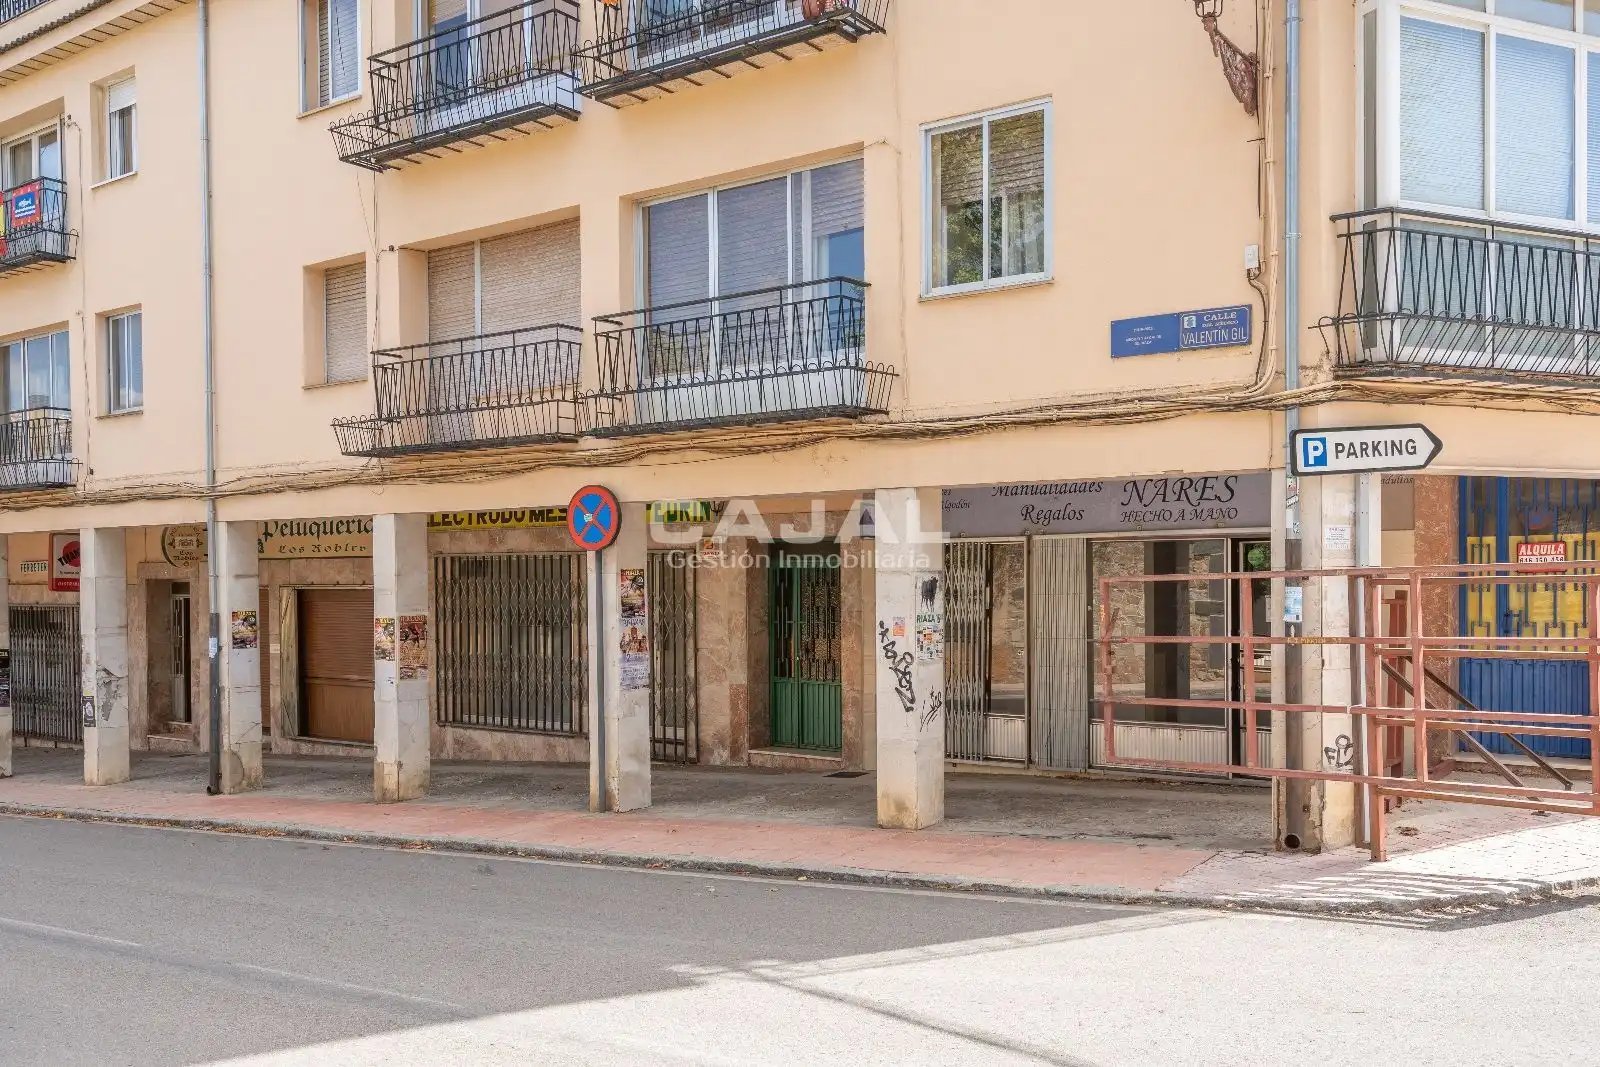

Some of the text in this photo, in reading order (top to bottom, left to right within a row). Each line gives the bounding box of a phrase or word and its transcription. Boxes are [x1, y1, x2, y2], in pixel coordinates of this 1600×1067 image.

[1203, 311, 1237, 322] CALLE
[1182, 325, 1247, 345] VALENTÍN GIL
[1307, 438, 1417, 465] P PARKING
[1120, 475, 1238, 507] NARES
[942, 498, 970, 512] lgodón
[1020, 502, 1085, 526] Regalos
[1120, 507, 1238, 523] HECHO A MANO
[278, 542, 368, 554] Los Robles
[1519, 543, 1565, 556] ALQUILA
